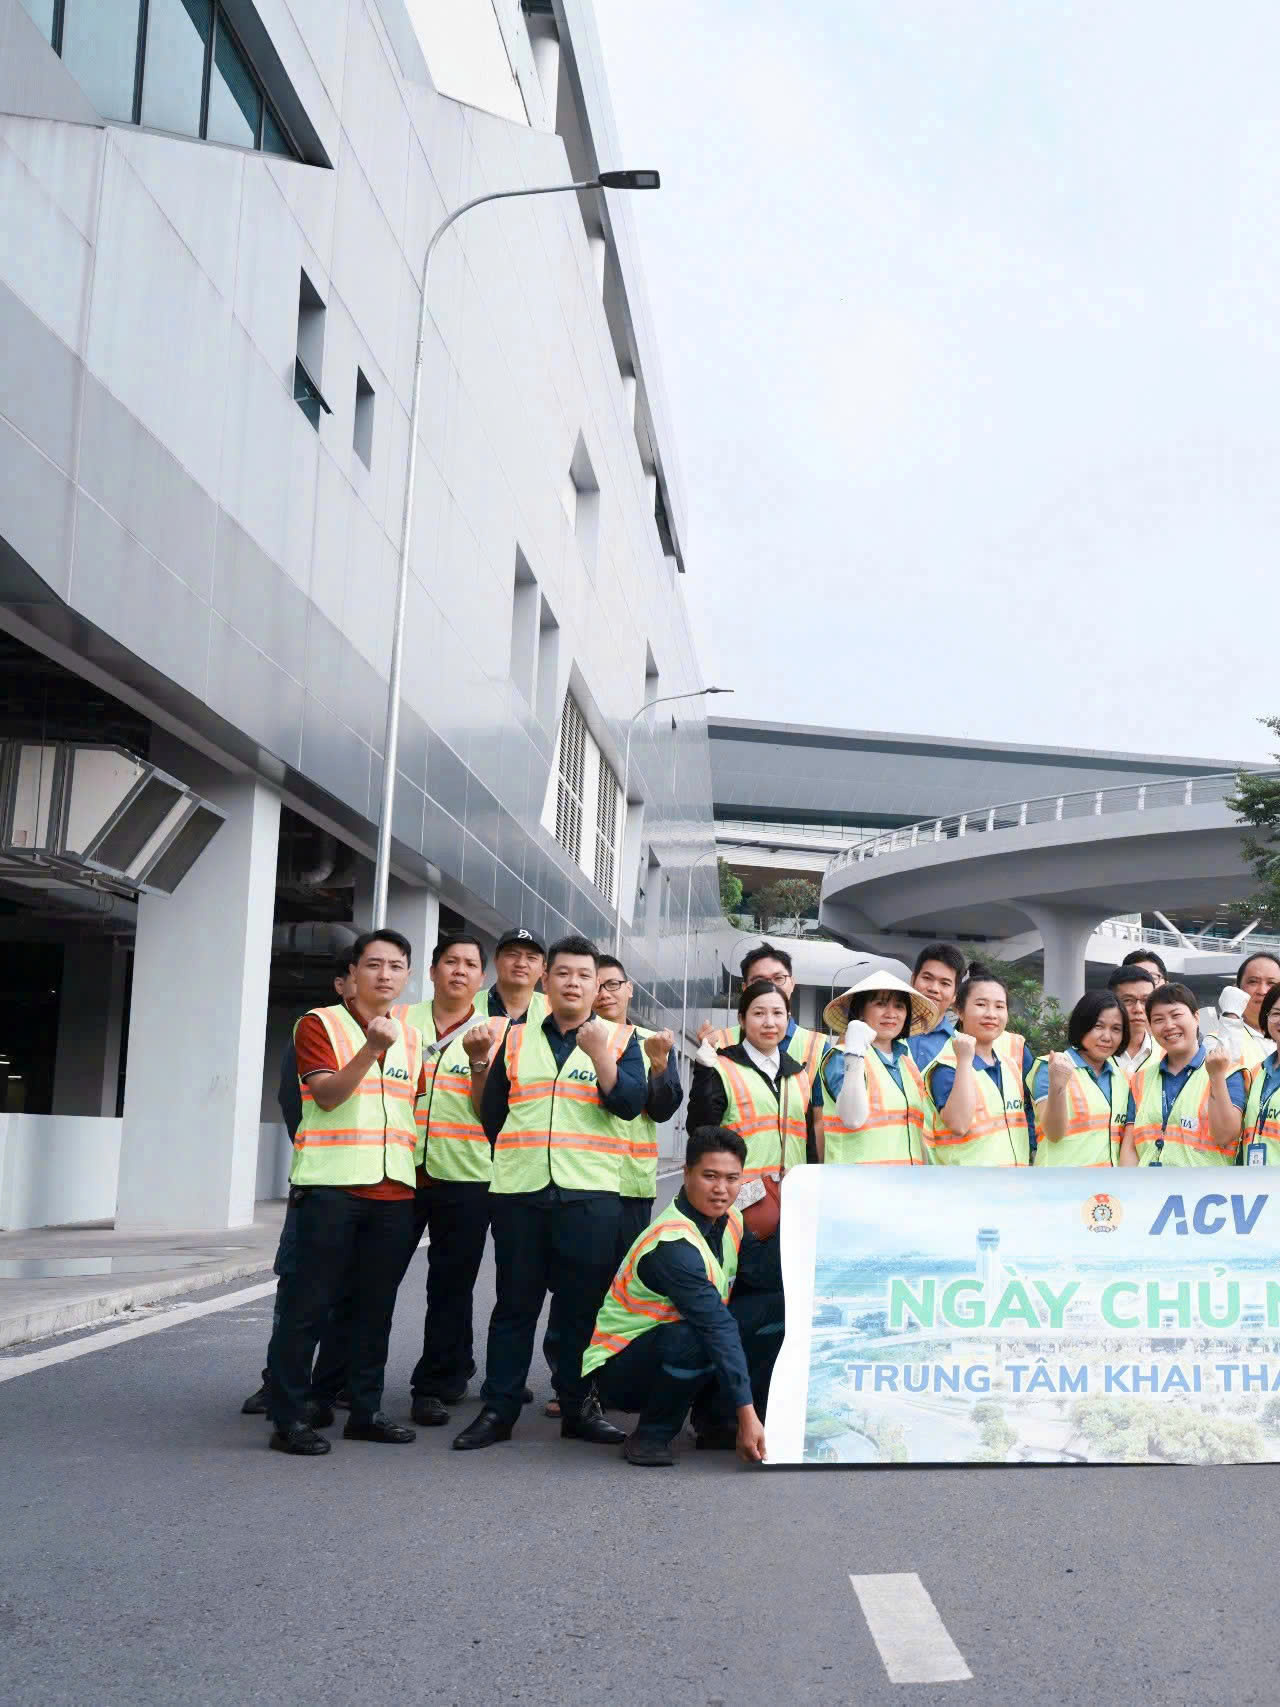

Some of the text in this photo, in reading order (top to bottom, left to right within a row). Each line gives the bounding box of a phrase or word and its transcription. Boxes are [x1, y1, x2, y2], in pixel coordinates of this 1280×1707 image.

[449, 1063, 471, 1075] AC
[568, 1068, 598, 1082] ACV
[1149, 1193, 1270, 1236] ACV
[889, 1265, 1082, 1330] NGÀY
[1101, 1267, 1241, 1330] CHỦ
[847, 1363, 992, 1393] TRUNG
[1005, 1357, 1089, 1393] TÂM
[1104, 1364, 1202, 1393] KHAI
